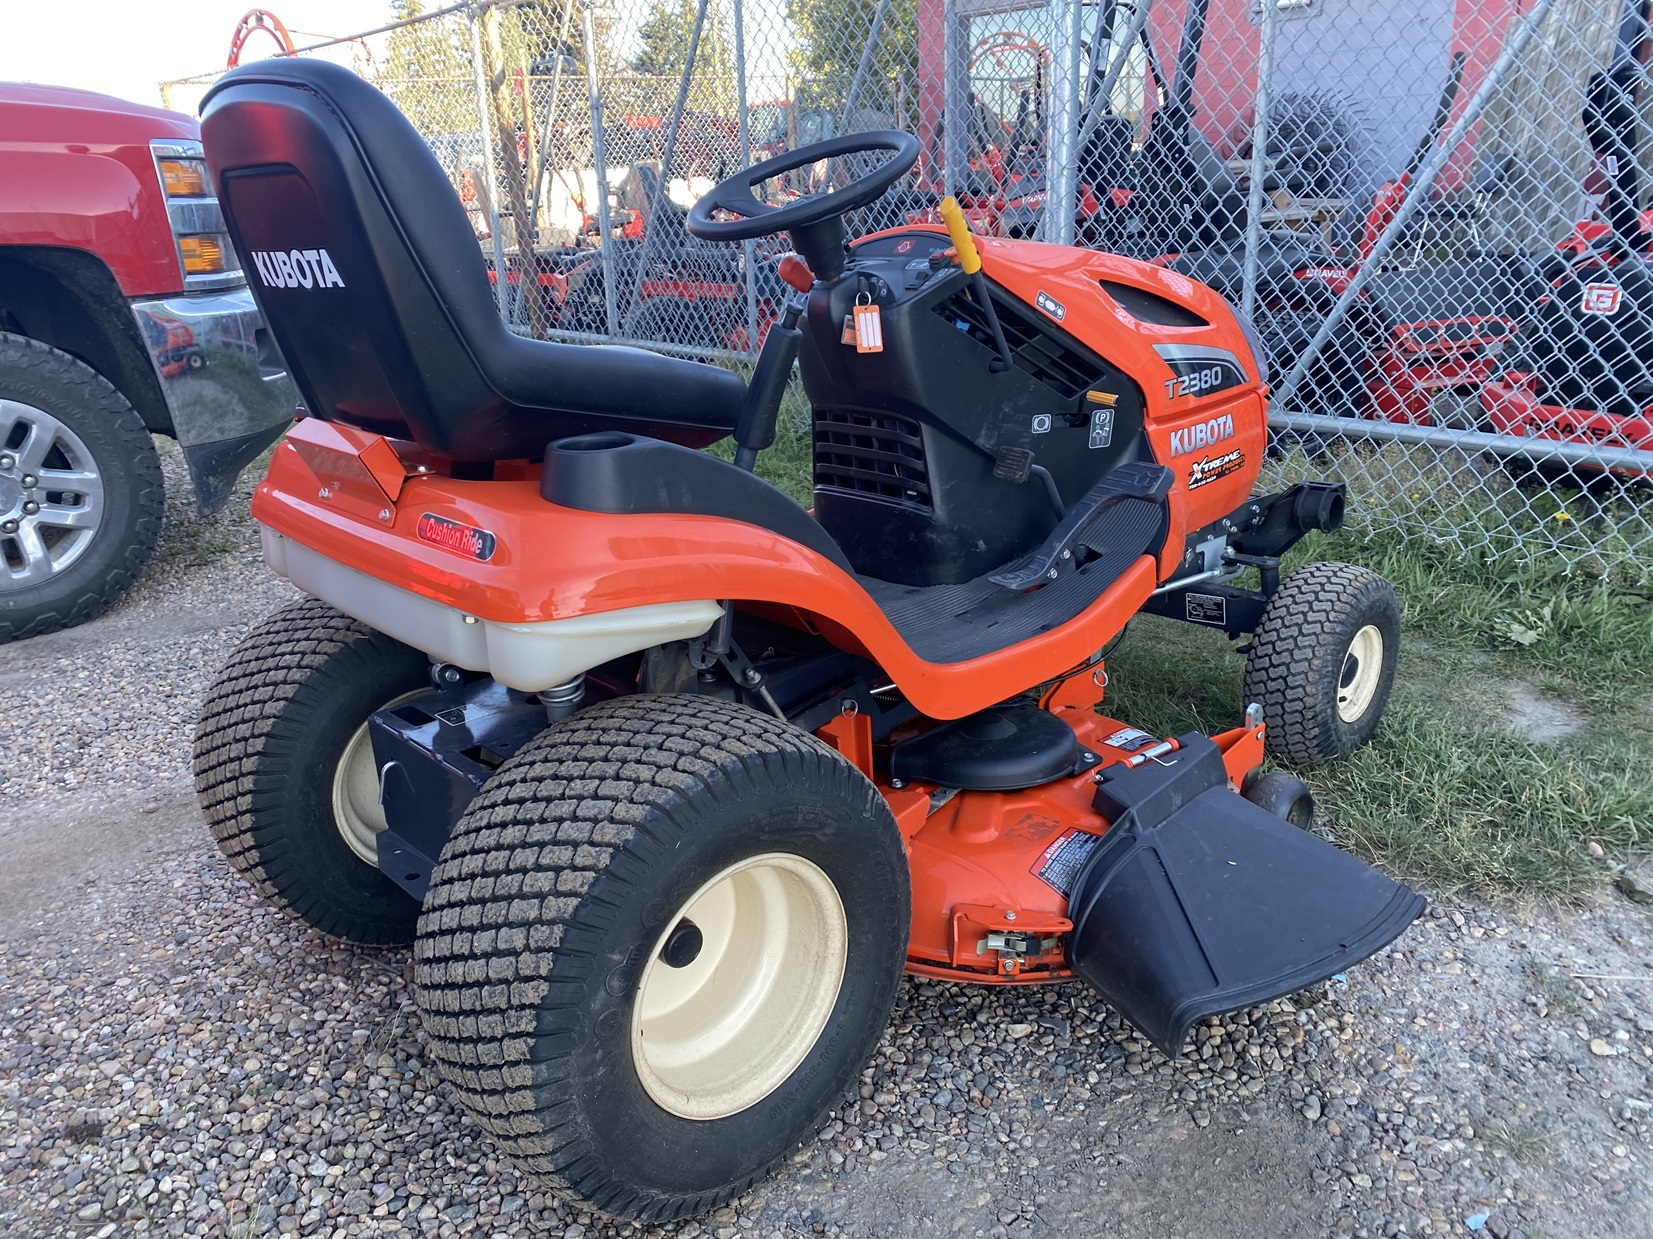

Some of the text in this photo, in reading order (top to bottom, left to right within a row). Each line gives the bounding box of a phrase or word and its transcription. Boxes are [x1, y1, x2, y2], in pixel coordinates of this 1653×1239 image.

[251, 249, 346, 289] KUBOTA
[1164, 366, 1222, 400] T2380
[1169, 413, 1235, 458] KUBOTA
[1188, 449, 1241, 485] XTREME
[426, 518, 483, 554] Cushion Ride
